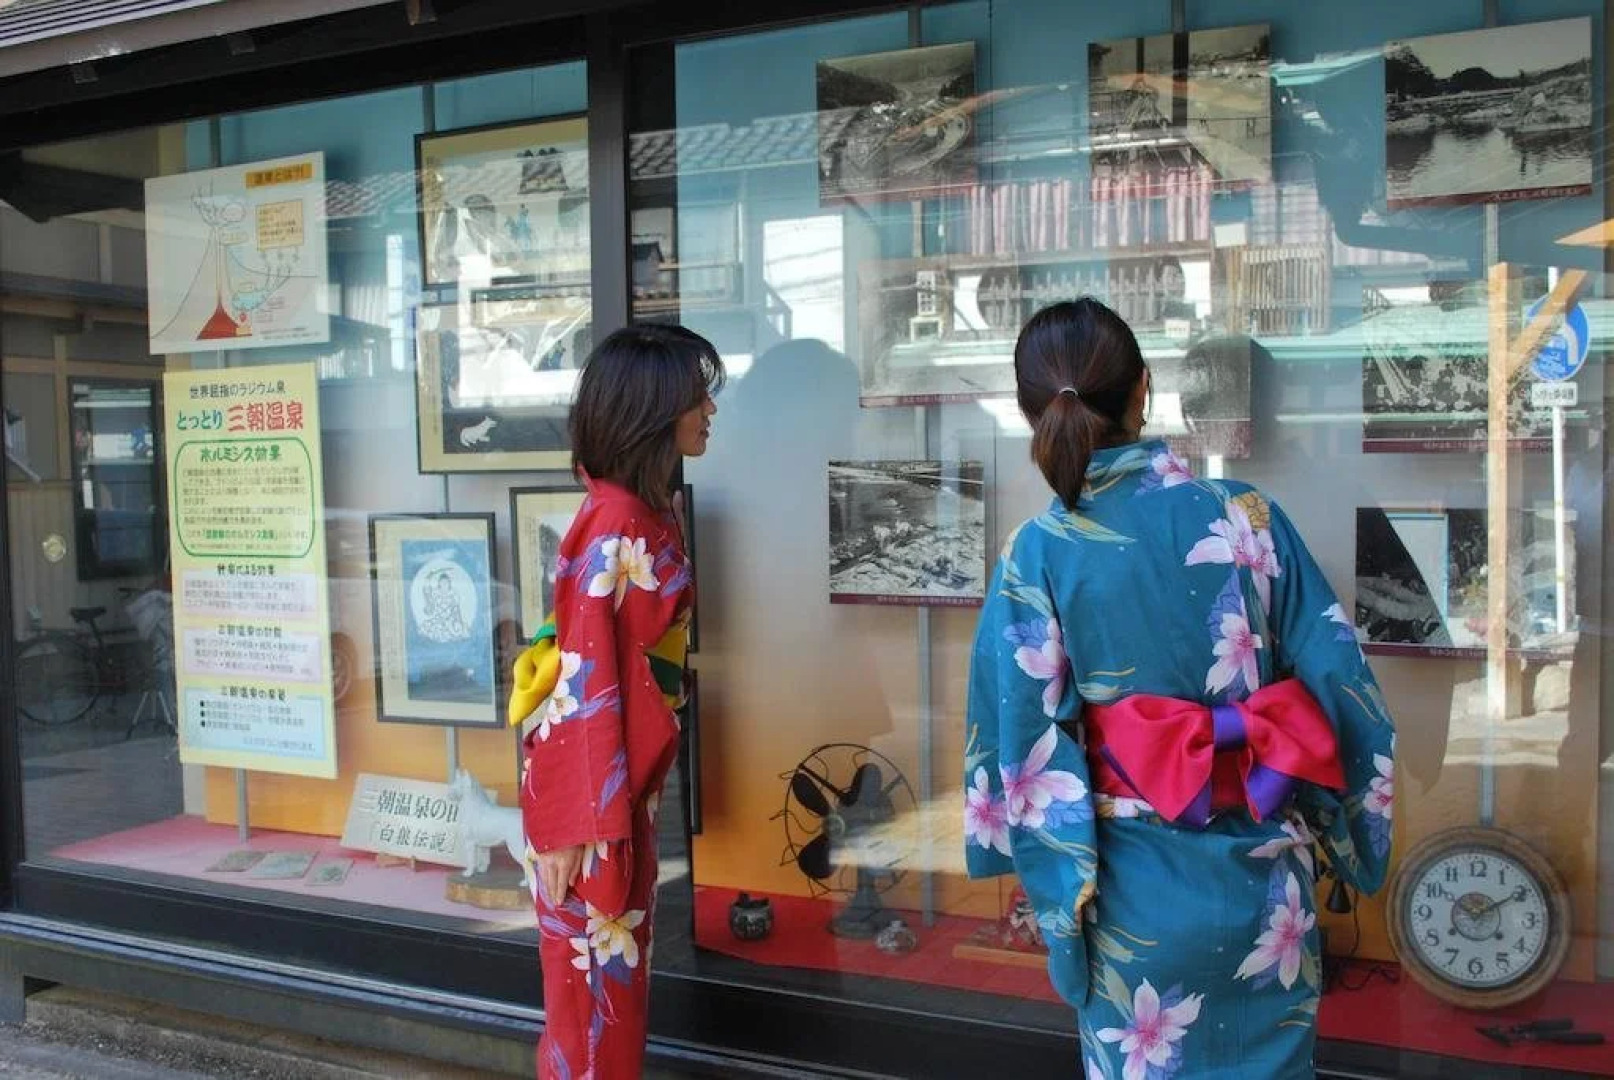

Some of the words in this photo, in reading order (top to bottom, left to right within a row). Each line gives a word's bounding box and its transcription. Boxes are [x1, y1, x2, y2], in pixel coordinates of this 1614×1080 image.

[177, 409, 223, 430] とっとり
[227, 400, 304, 432] 三朝温泉
[200, 444, 282, 463] ホルミシス効果
[1446, 867, 1458, 882] 11
[1470, 861, 1487, 877] 12
[1499, 869, 1506, 884] 1
[1427, 883, 1441, 897] 10
[1513, 885, 1526, 901] 2
[1418, 905, 1432, 921] 9
[1522, 912, 1535, 929] 3
[1426, 929, 1439, 946] 8
[1512, 936, 1525, 953] 4
[1445, 948, 1459, 965] 7
[1496, 952, 1509, 972] 5
[1468, 957, 1483, 975] 6
